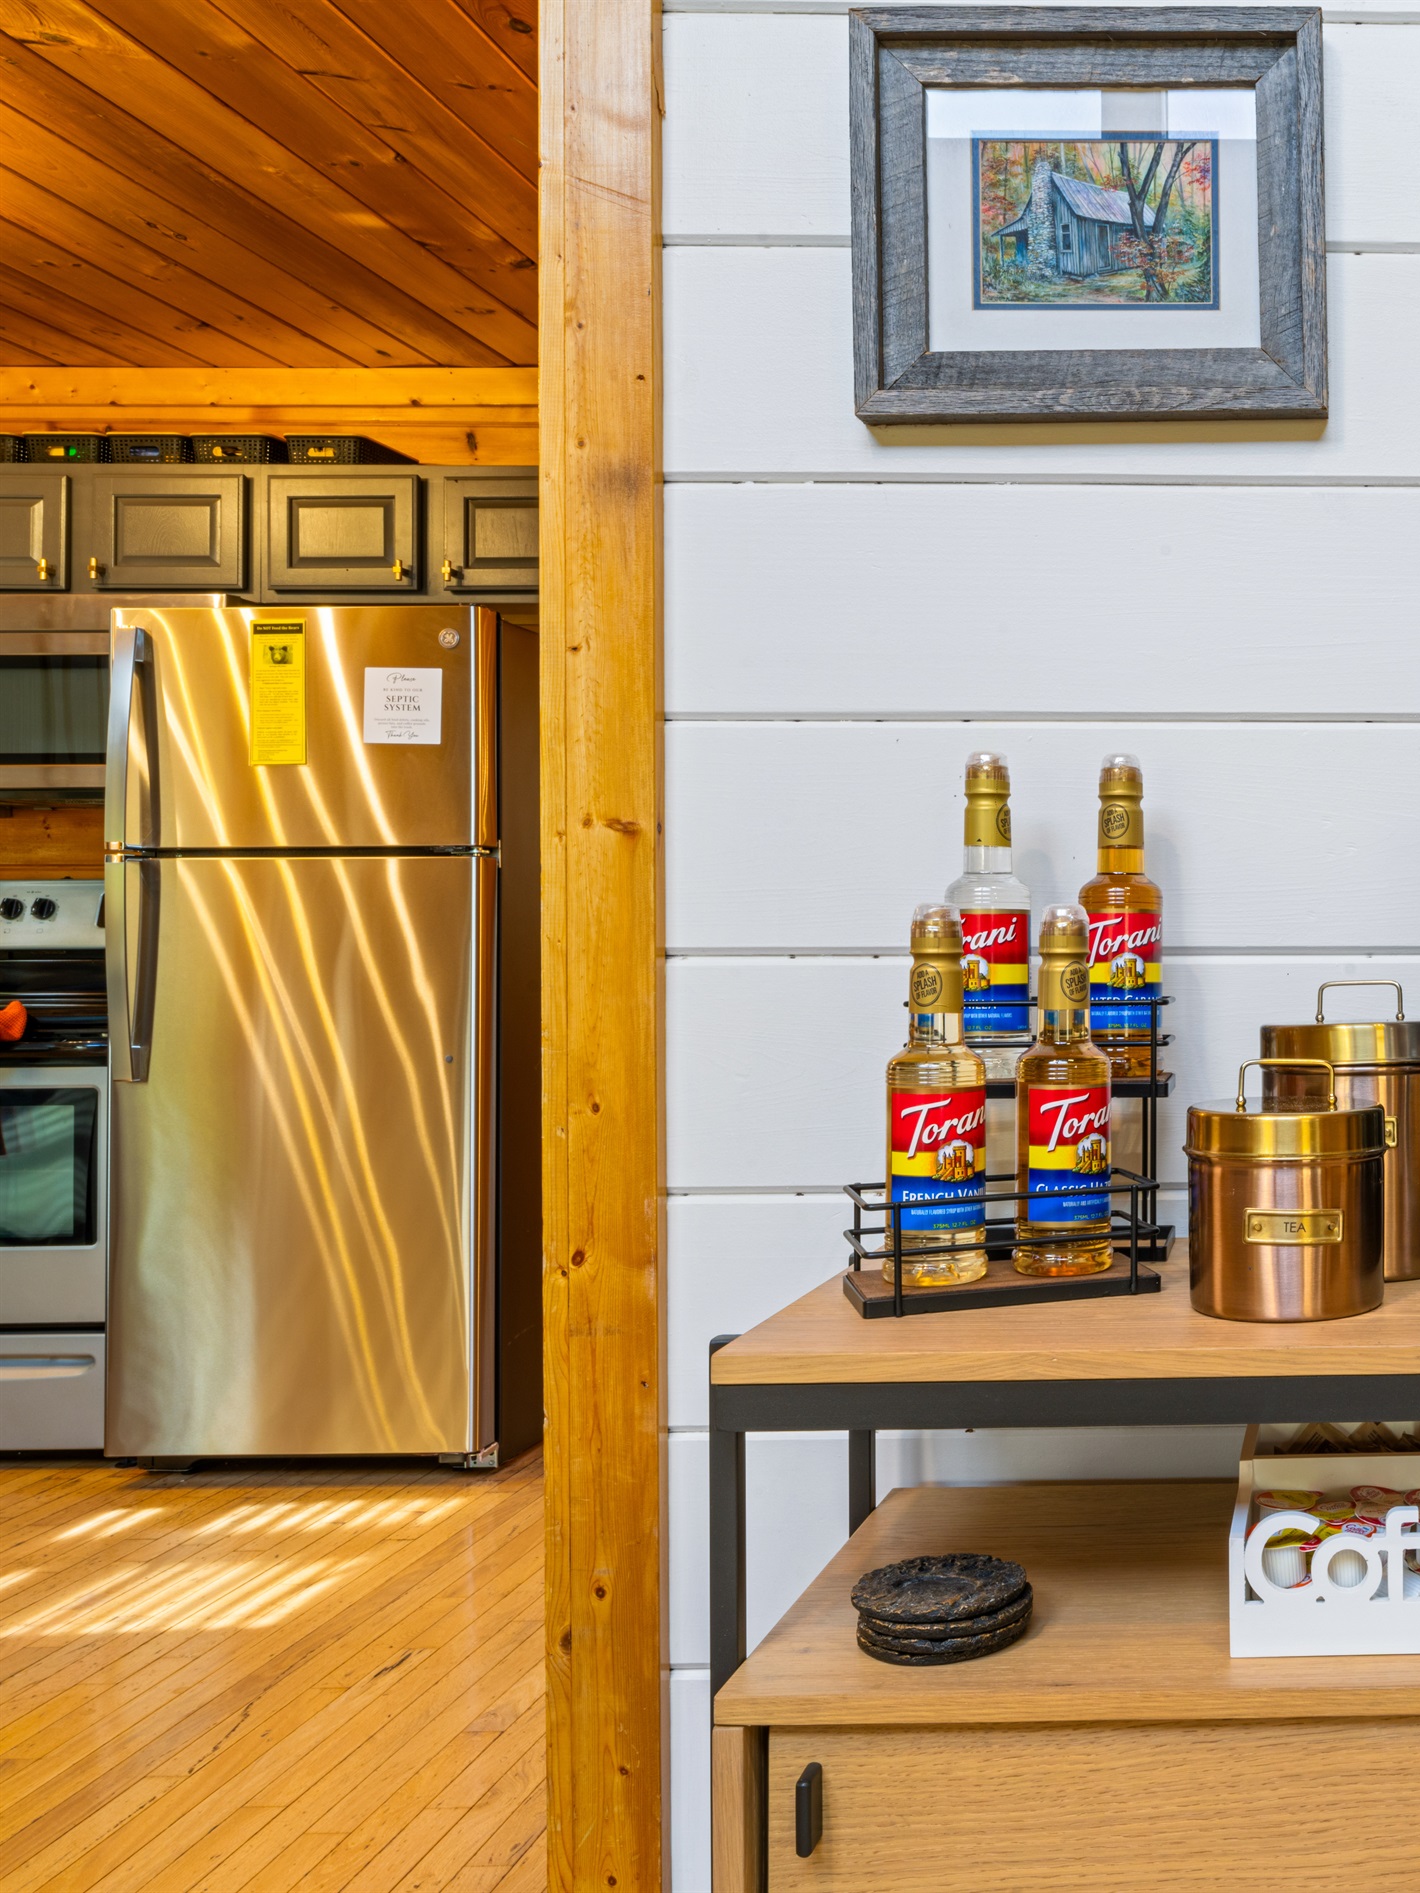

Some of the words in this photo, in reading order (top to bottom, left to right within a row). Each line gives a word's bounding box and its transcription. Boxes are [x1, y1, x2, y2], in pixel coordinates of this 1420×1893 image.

[386, 695, 420, 703] SEPTIC
[384, 704, 421, 712] SYSTEM
[1104, 813, 1125, 828] SPLASH
[960, 917, 1018, 951] rani
[1088, 917, 1163, 968] Torani
[913, 976, 937, 992] SPLASH
[901, 1097, 986, 1159] Toran
[1040, 1092, 1111, 1152] Tora
[1283, 1222, 1306, 1233] TEA
